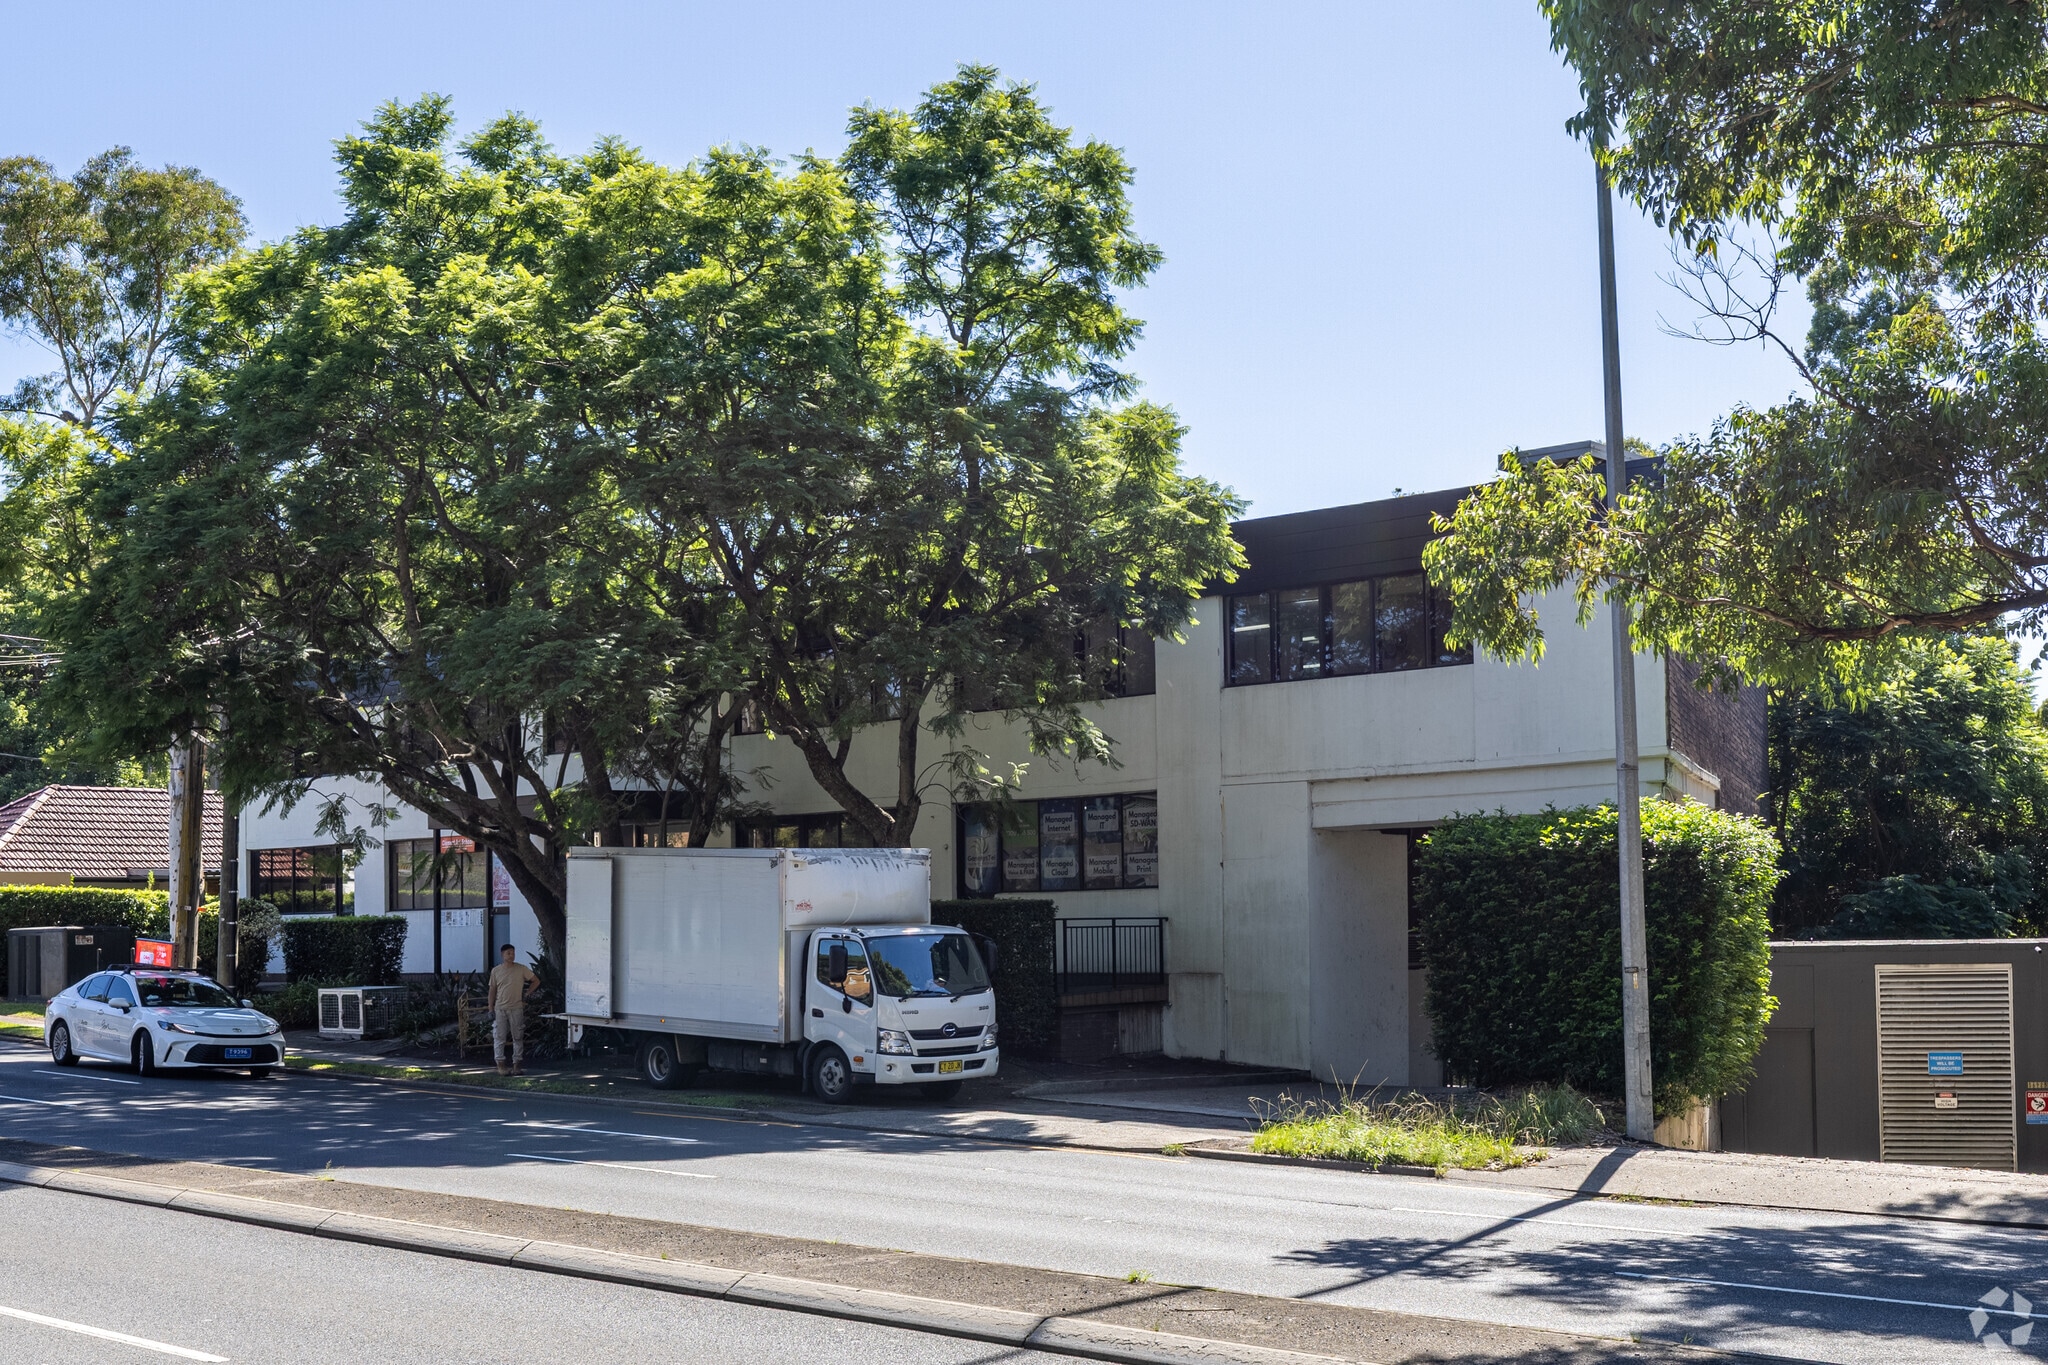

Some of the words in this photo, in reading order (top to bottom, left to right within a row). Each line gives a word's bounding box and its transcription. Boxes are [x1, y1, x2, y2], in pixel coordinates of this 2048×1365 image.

[1088, 811, 1117, 821] Managed
[1128, 809, 1157, 818] Managed
[1044, 815, 1073, 824] Managed
[1007, 860, 1035, 869] Managed
[1045, 860, 1074, 868] Managed
[1088, 857, 1117, 866] Managed
[1129, 856, 1158, 865] Managed
[1093, 866, 1114, 874] Mobile
